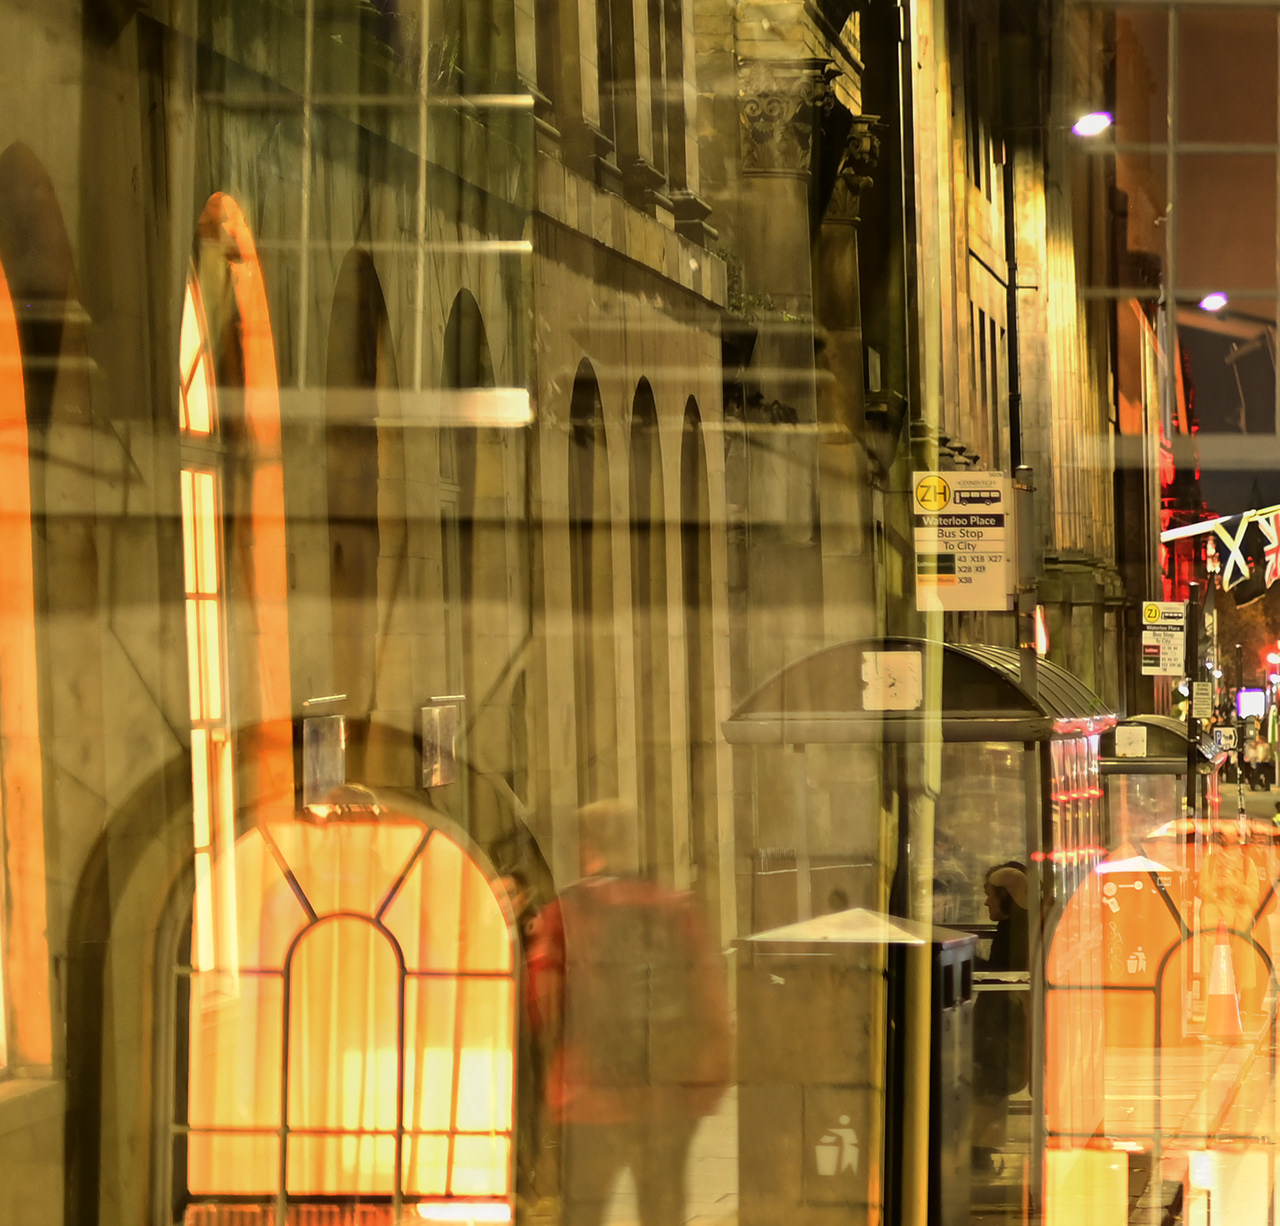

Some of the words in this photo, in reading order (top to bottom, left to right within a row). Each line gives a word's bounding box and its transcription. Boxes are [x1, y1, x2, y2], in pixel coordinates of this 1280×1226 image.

[919, 485, 947, 502] ZH
[922, 516, 968, 526] Waterloo
[970, 515, 996, 526] Place
[937, 529, 956, 538] Bus
[959, 529, 984, 540] Stop
[943, 541, 955, 551] To
[957, 541, 977, 552] City
[1147, 608, 1158, 619] ZJ
